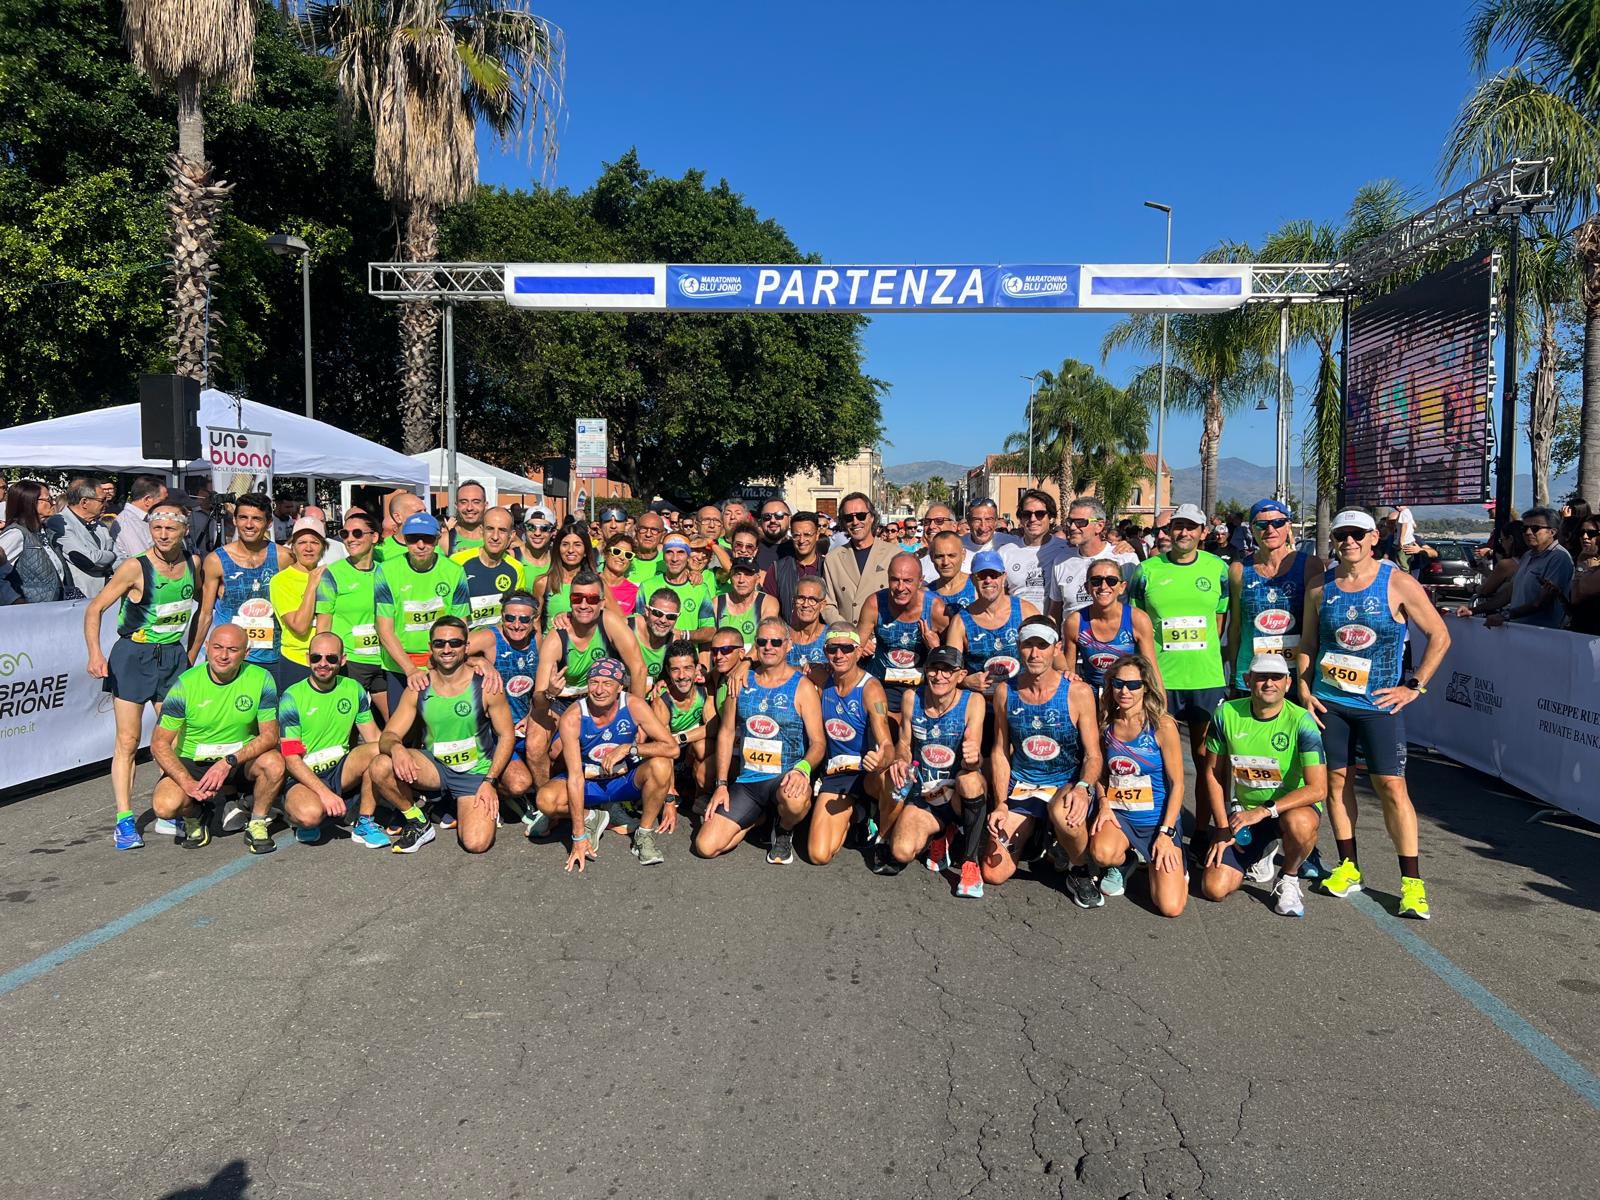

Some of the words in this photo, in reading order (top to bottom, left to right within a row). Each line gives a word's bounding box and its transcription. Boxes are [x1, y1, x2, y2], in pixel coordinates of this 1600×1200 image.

[1025, 275, 1067, 283] MARATONINA
[700, 283, 715, 292] BLU
[717, 283, 742, 292] JONIO
[754, 269, 984, 305] PARTENZA
[1023, 282, 1040, 291] BLU
[1042, 282, 1068, 291] JONIO
[210, 445, 271, 469] buono
[413, 610, 437, 622] 817
[473, 607, 495, 619] 821
[245, 628, 266, 639] 53
[1171, 629, 1199, 640] 913
[1327, 666, 1358, 682] 450
[1474, 677, 1495, 693] BANCA
[1473, 690, 1503, 708] GENERALI
[1537, 697, 1580, 720] GIUSEPPE
[1580, 709, 1600, 726] RUE
[1539, 719, 1573, 740] PRIVATE
[1573, 729, 1600, 750] BANK
[443, 751, 470, 764] 815
[749, 751, 773, 764] 447
[1242, 768, 1272, 779] 138
[1114, 789, 1142, 800] 457
